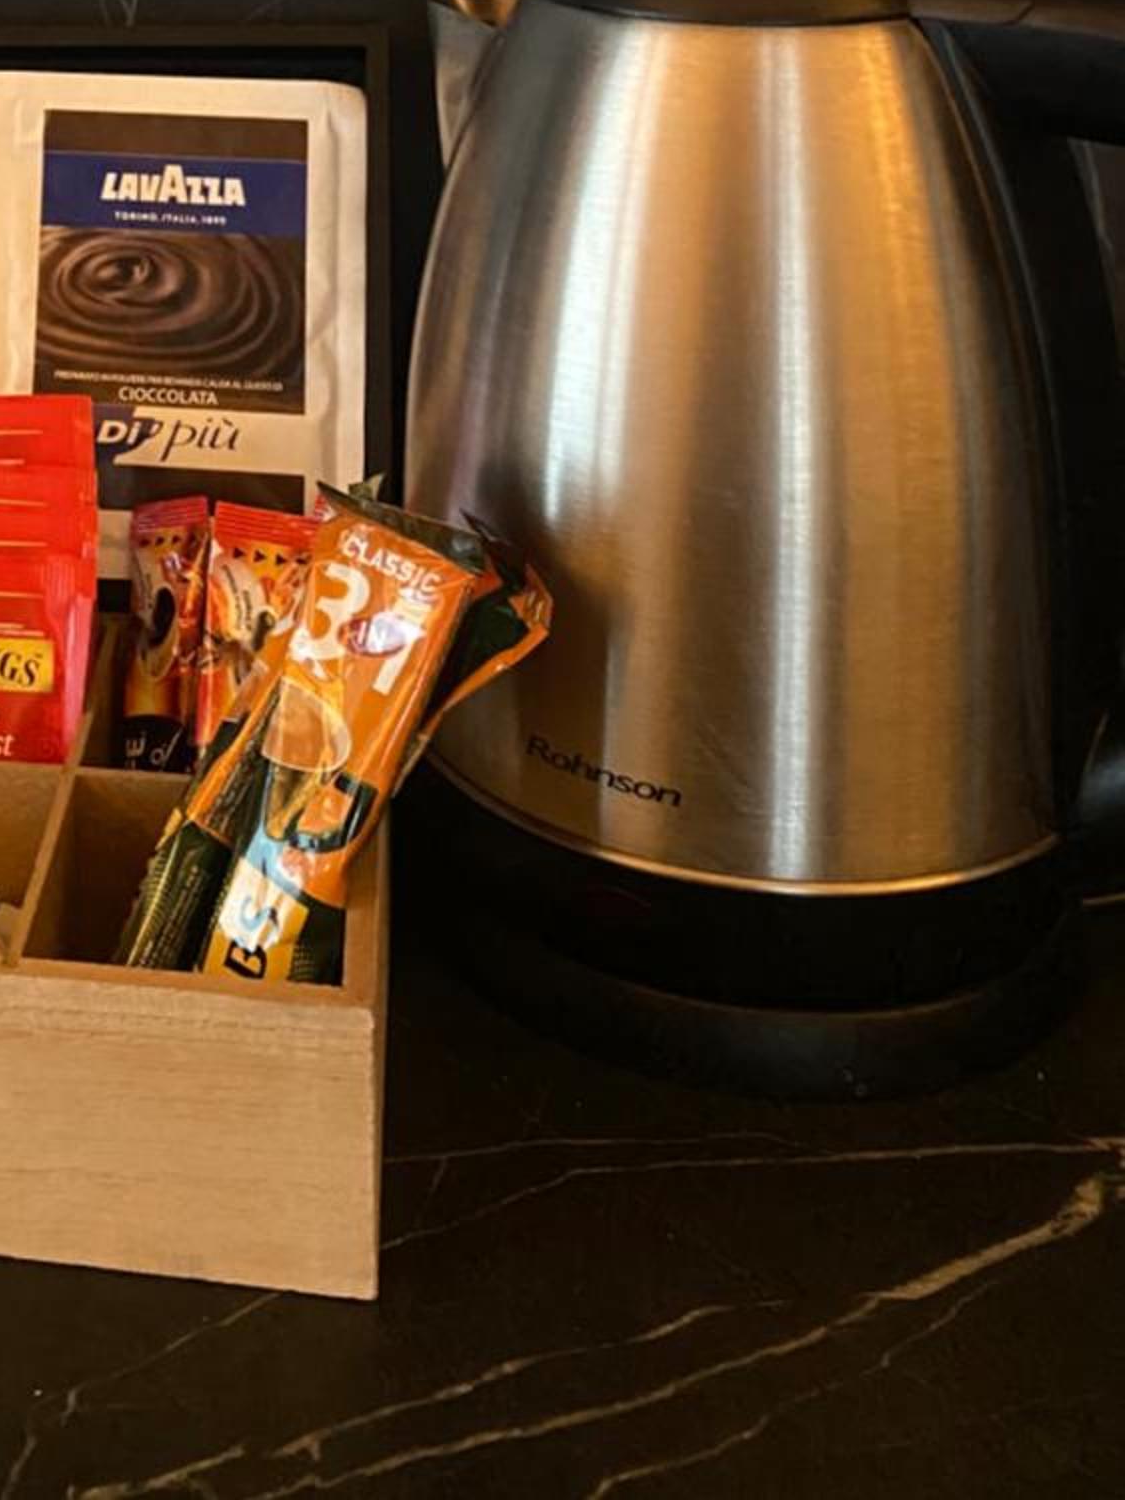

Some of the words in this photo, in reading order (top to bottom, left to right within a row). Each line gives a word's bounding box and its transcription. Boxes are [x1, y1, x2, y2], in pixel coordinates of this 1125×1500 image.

[100, 164, 246, 207] LAVAZZA
[118, 386, 219, 406] CIOCCOLATA
[161, 418, 240, 463] più
[342, 531, 442, 594] CLASSIC
